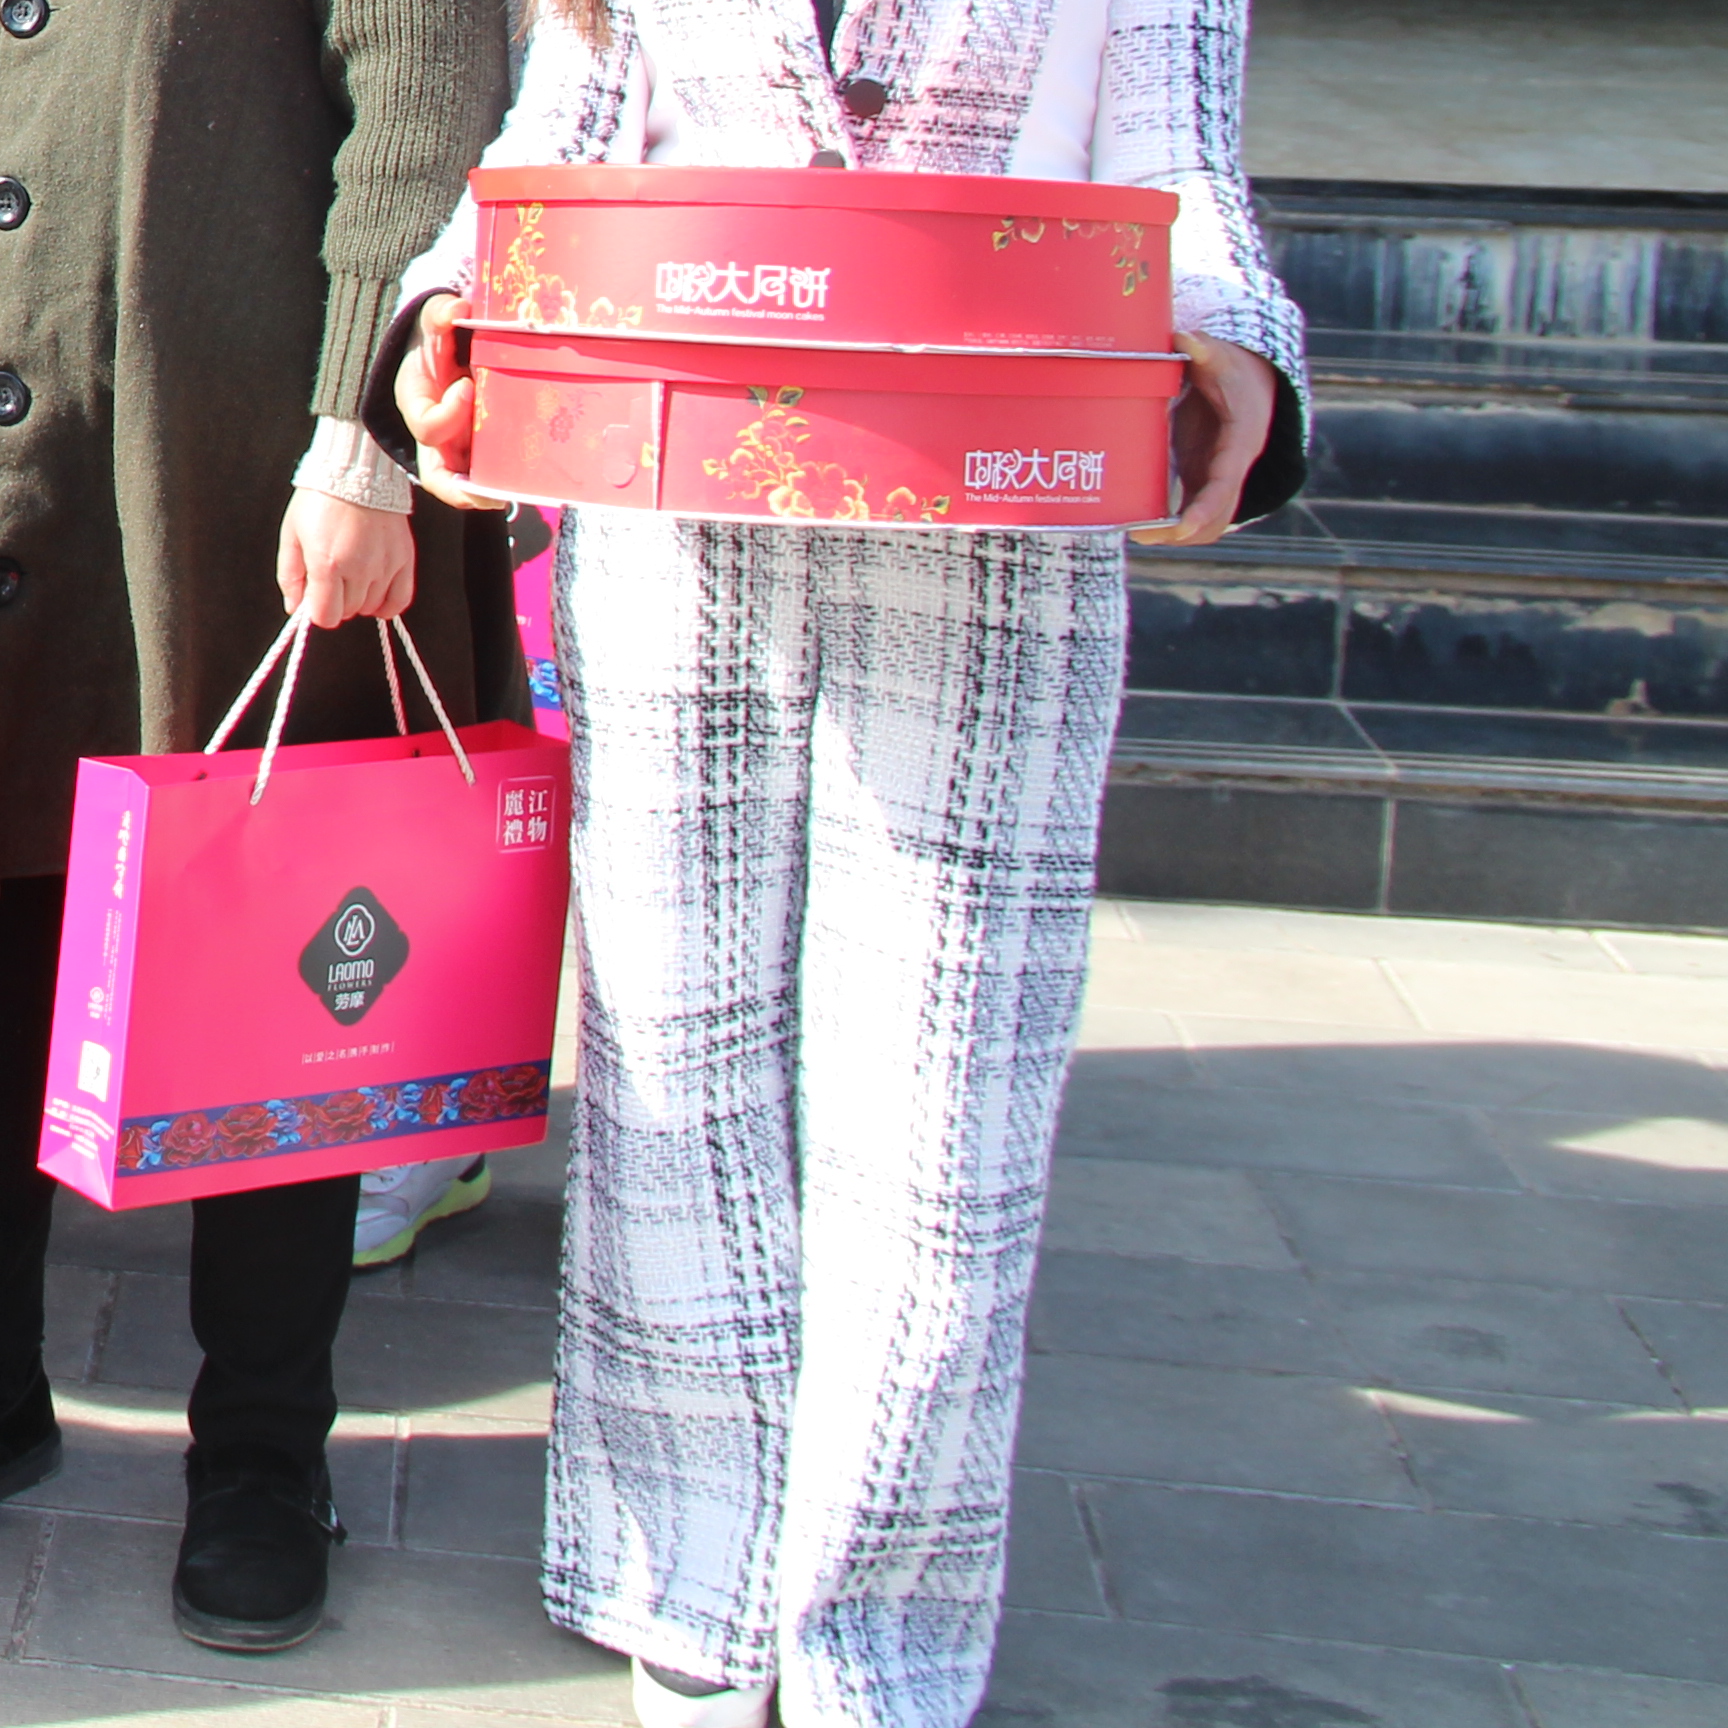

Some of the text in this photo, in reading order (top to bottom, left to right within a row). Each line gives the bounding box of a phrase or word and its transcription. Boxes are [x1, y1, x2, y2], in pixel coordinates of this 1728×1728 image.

[655, 261, 832, 308] 中秋大月饼
[656, 303, 673, 314] The
[674, 305, 730, 317] Mid-Autumn
[731, 307, 766, 319] festival
[767, 312, 794, 320] moon
[964, 448, 1105, 490] 中秋大月饼
[965, 492, 982, 502] The
[984, 494, 1034, 503] Mid-Autumn
[328, 958, 374, 983] LAOMO
[327, 979, 373, 991] FLOWERS
[334, 991, 365, 1011] 劳摩
